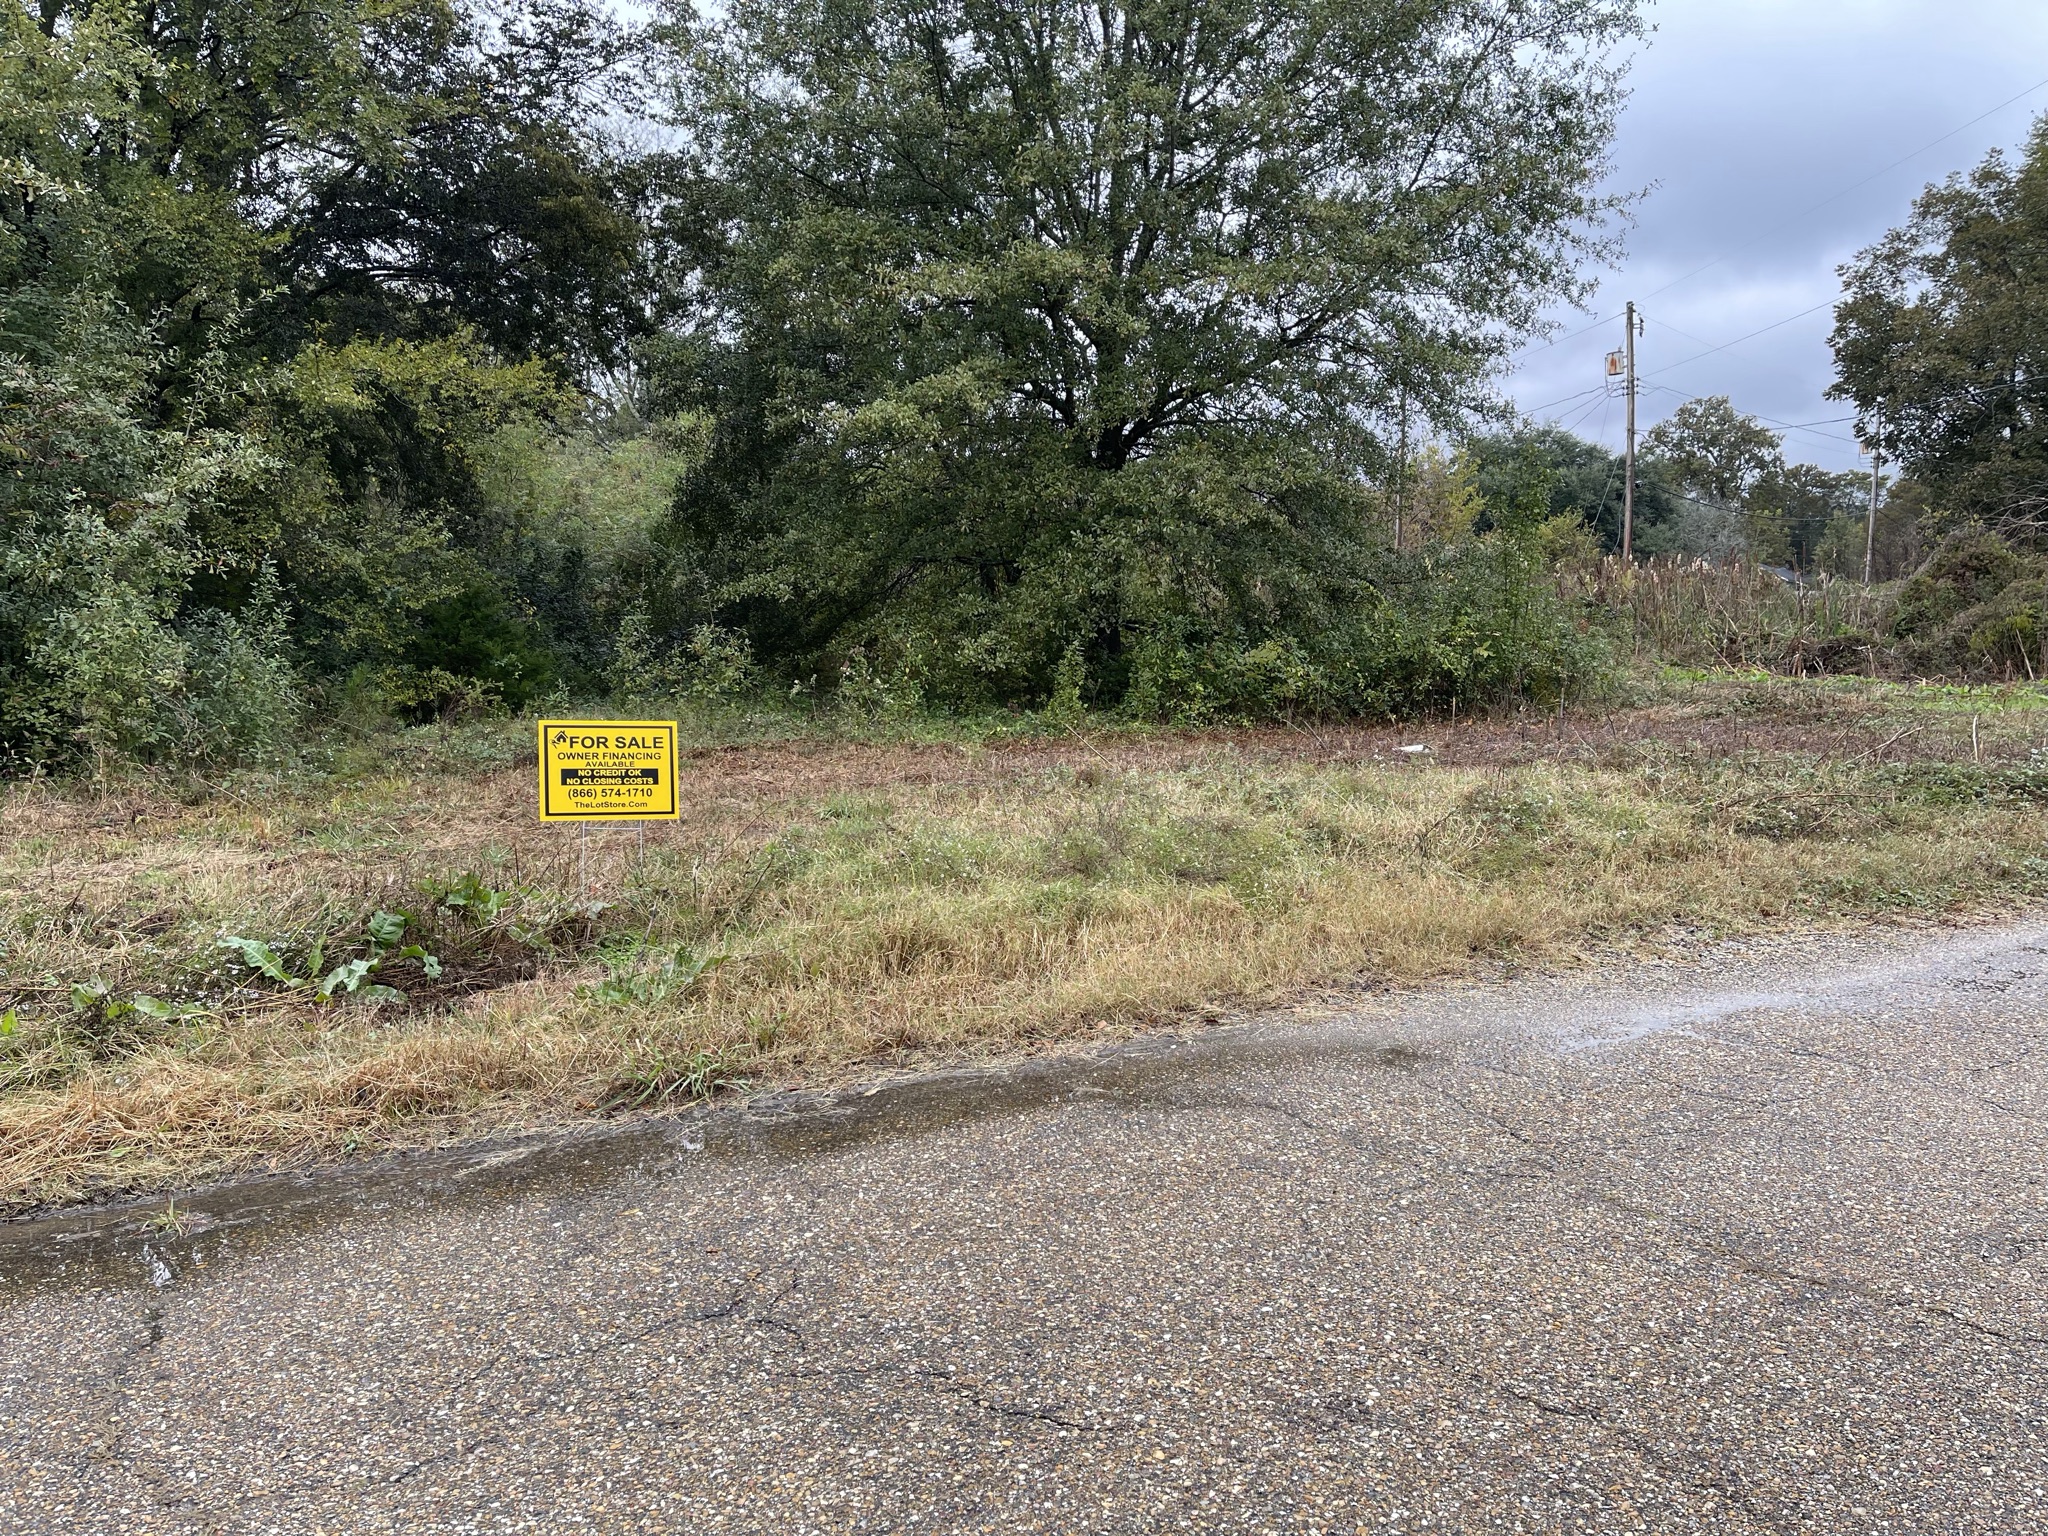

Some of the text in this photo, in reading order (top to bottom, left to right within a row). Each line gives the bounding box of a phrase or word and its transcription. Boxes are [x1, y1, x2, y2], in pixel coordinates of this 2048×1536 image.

[569, 736, 664, 749] FOR SALE
[557, 752, 661, 760] OWNER FINANCING
[566, 777, 654, 785] NO CLOSING COSTS
[568, 788, 653, 800] (866) 574-1710
